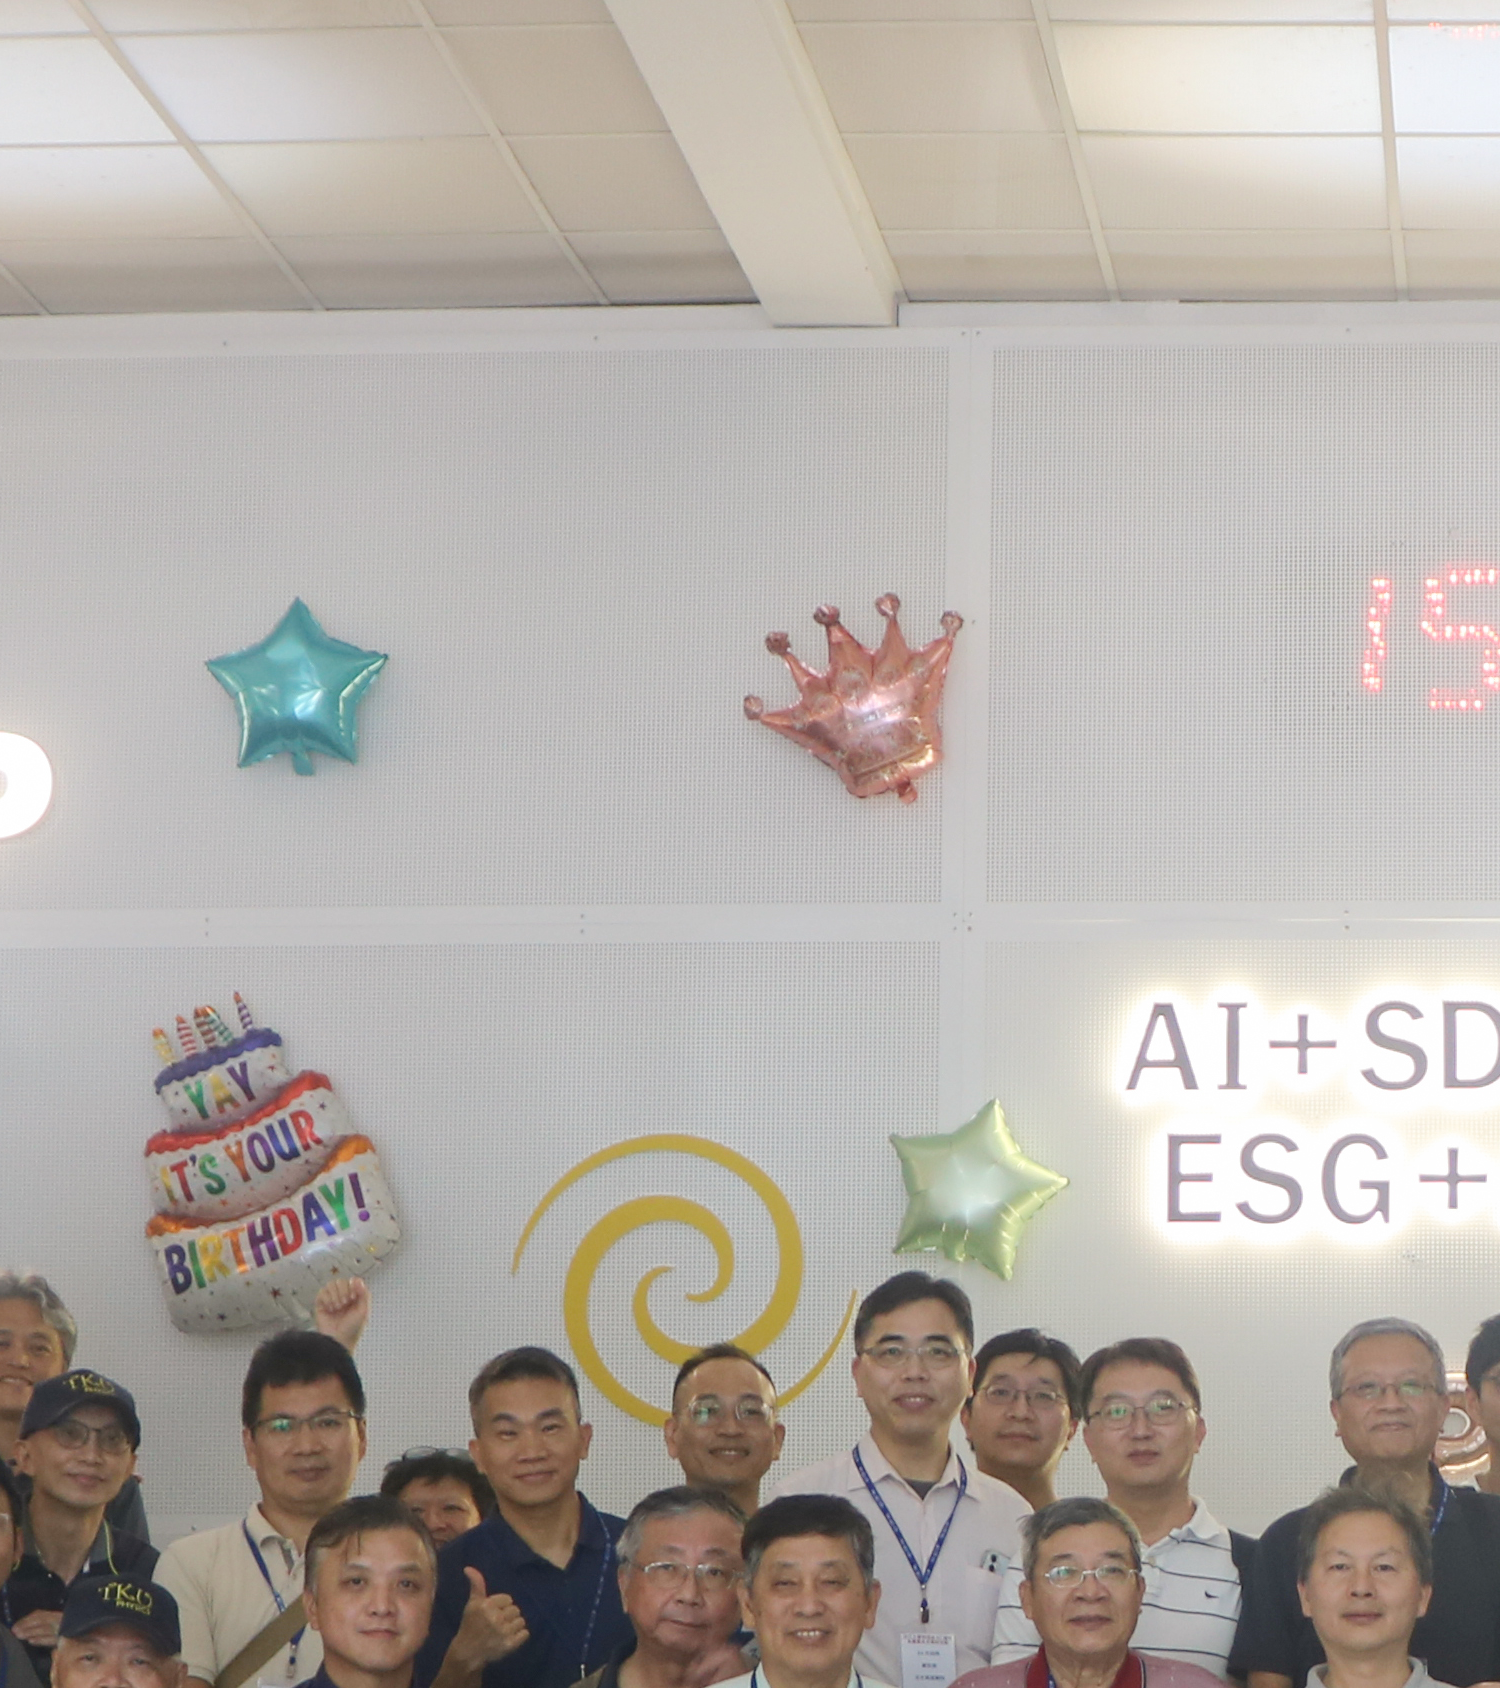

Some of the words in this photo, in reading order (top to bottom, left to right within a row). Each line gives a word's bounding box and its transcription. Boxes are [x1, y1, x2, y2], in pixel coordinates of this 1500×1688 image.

[183, 1061, 257, 1120] YAY
[160, 1153, 227, 1204] IT'S
[224, 1110, 324, 1183] YOUR
[164, 1172, 371, 1295] BIRTHDAY!
